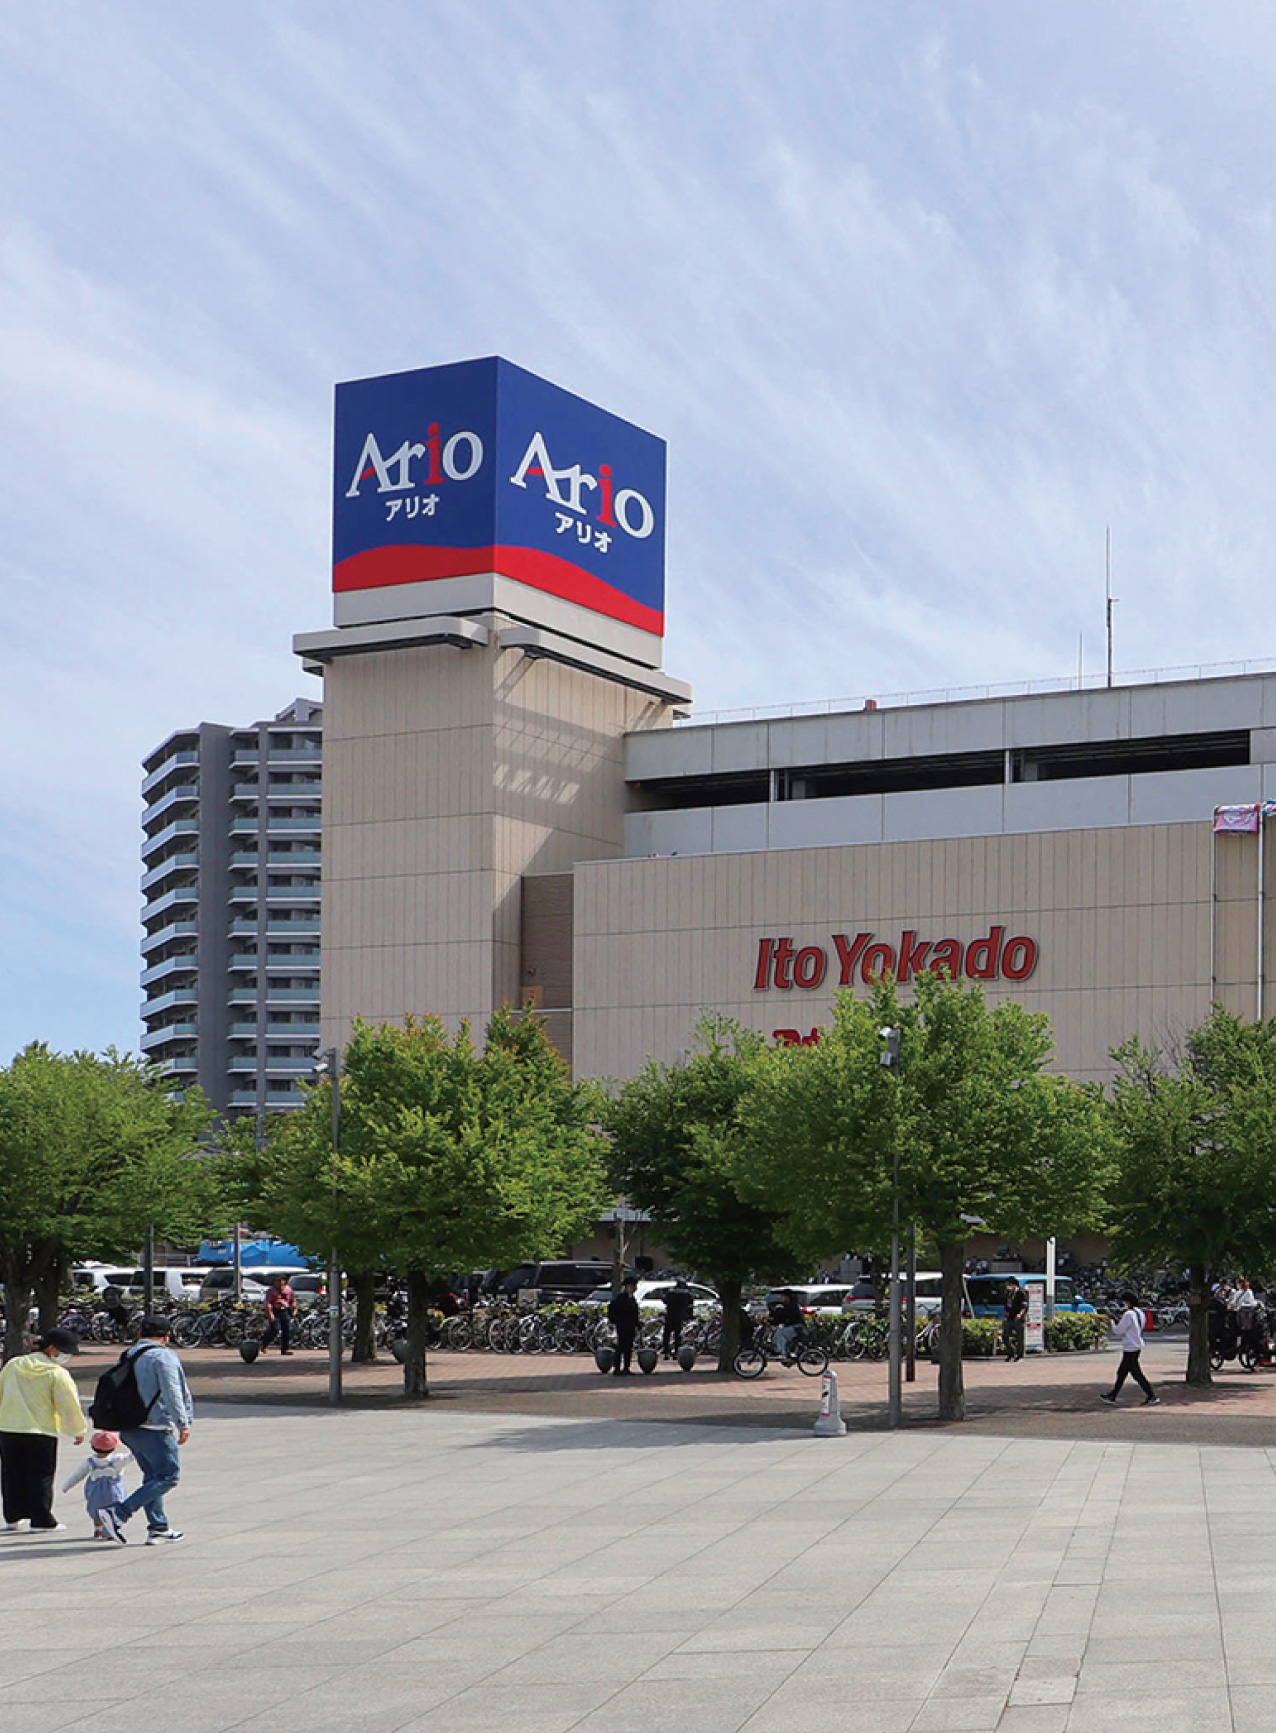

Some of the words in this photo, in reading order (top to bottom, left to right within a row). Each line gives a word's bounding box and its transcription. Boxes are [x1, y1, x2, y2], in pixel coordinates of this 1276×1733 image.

[345, 421, 483, 497] Ario
[509, 431, 655, 539] Ario
[385, 493, 440, 521] アリオ
[554, 512, 612, 553] アリオ
[754, 937, 827, 991] Ito
[832, 925, 1038, 987] Yokado
